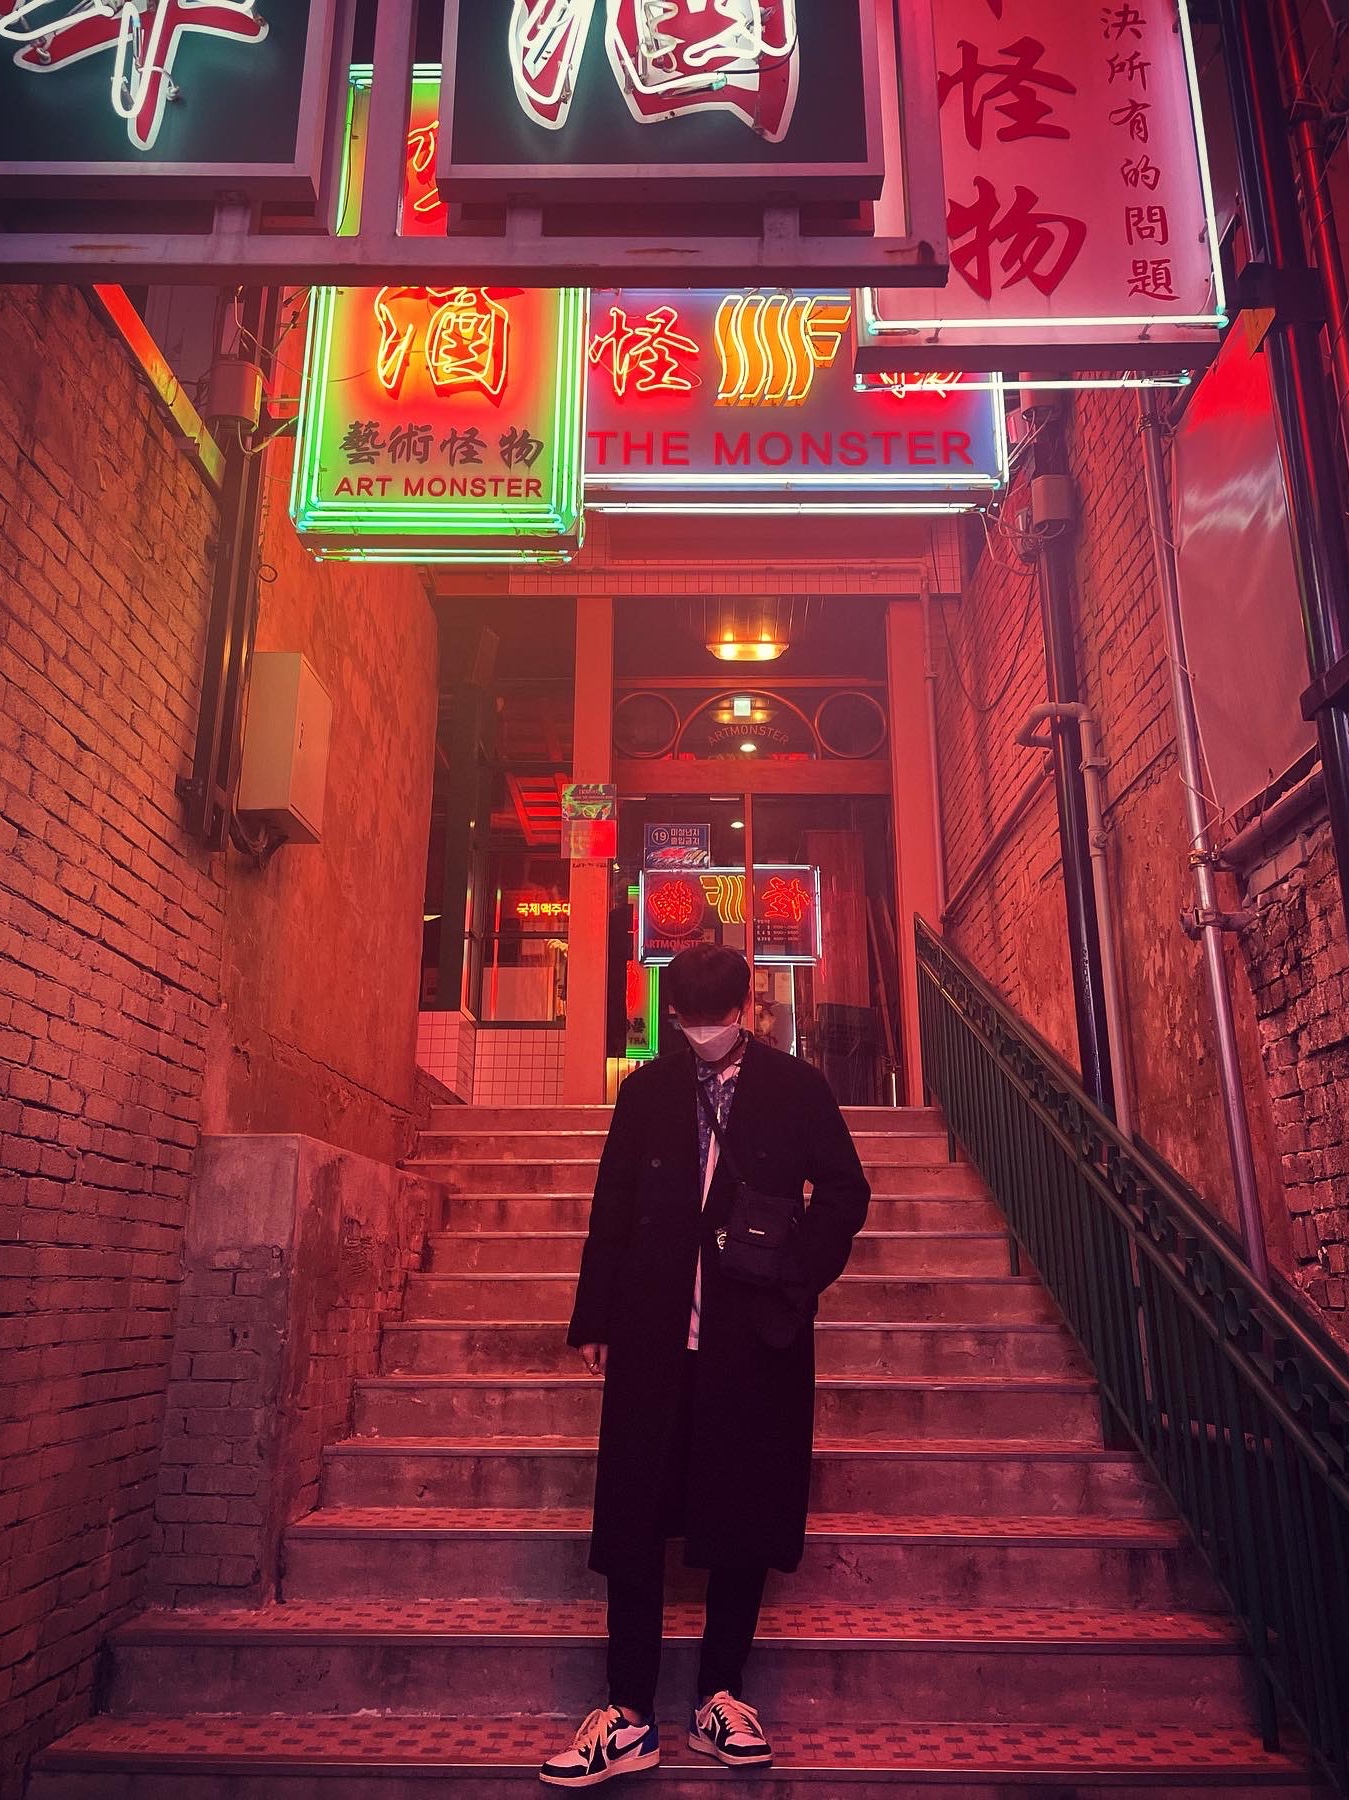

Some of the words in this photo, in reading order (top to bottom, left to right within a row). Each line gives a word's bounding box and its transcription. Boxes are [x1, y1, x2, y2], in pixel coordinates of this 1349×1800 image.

[938, 0, 1087, 301] 怪物
[1100, 3, 1181, 302] 決所有的問題
[339, 421, 545, 470] 藝術怪物
[586, 431, 691, 465] THE
[714, 431, 975, 466] MONSTER
[334, 477, 393, 498] ART
[403, 477, 544, 498] MONSTER
[707, 724, 790, 746] ARTMONSTER
[653, 831, 667, 841] 19
[645, 939, 701, 950] ARTMONSTE
